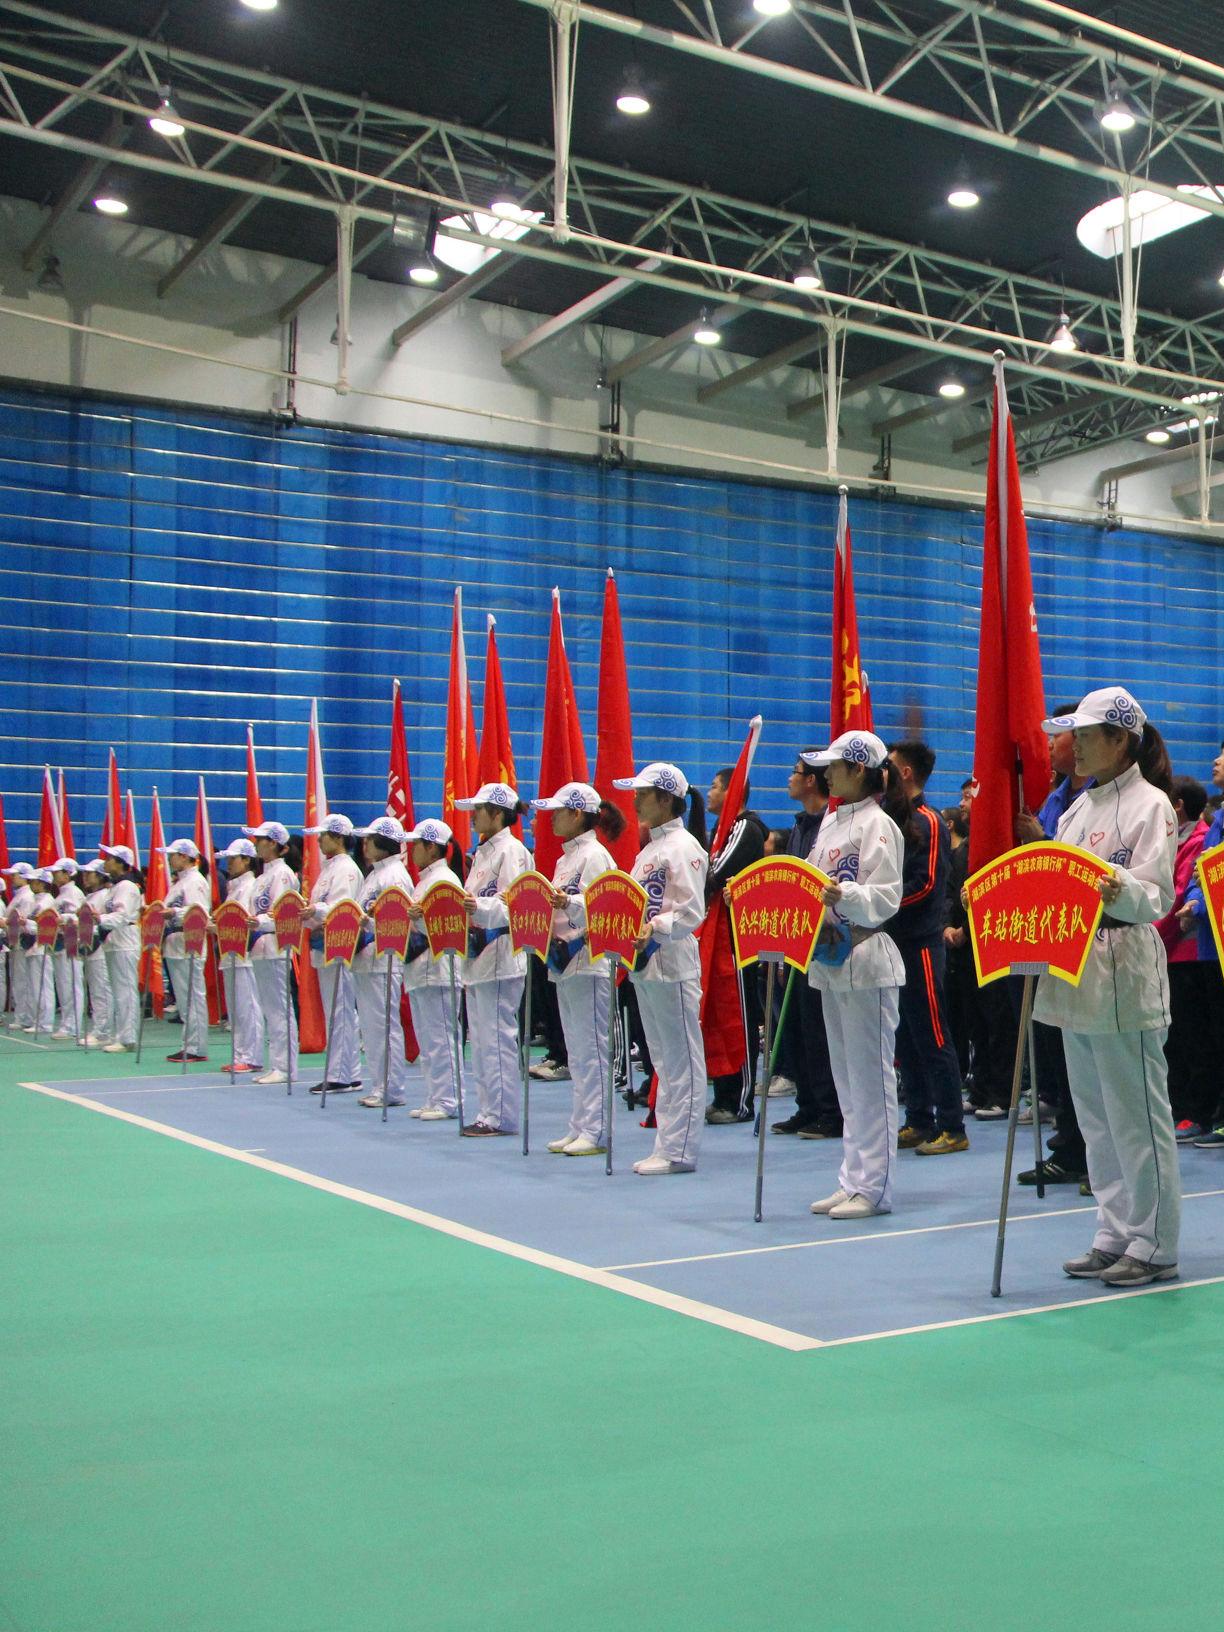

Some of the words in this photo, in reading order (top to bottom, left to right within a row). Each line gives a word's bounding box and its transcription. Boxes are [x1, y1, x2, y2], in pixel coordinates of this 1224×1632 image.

[979, 902, 1088, 946] 车站街道代表队
